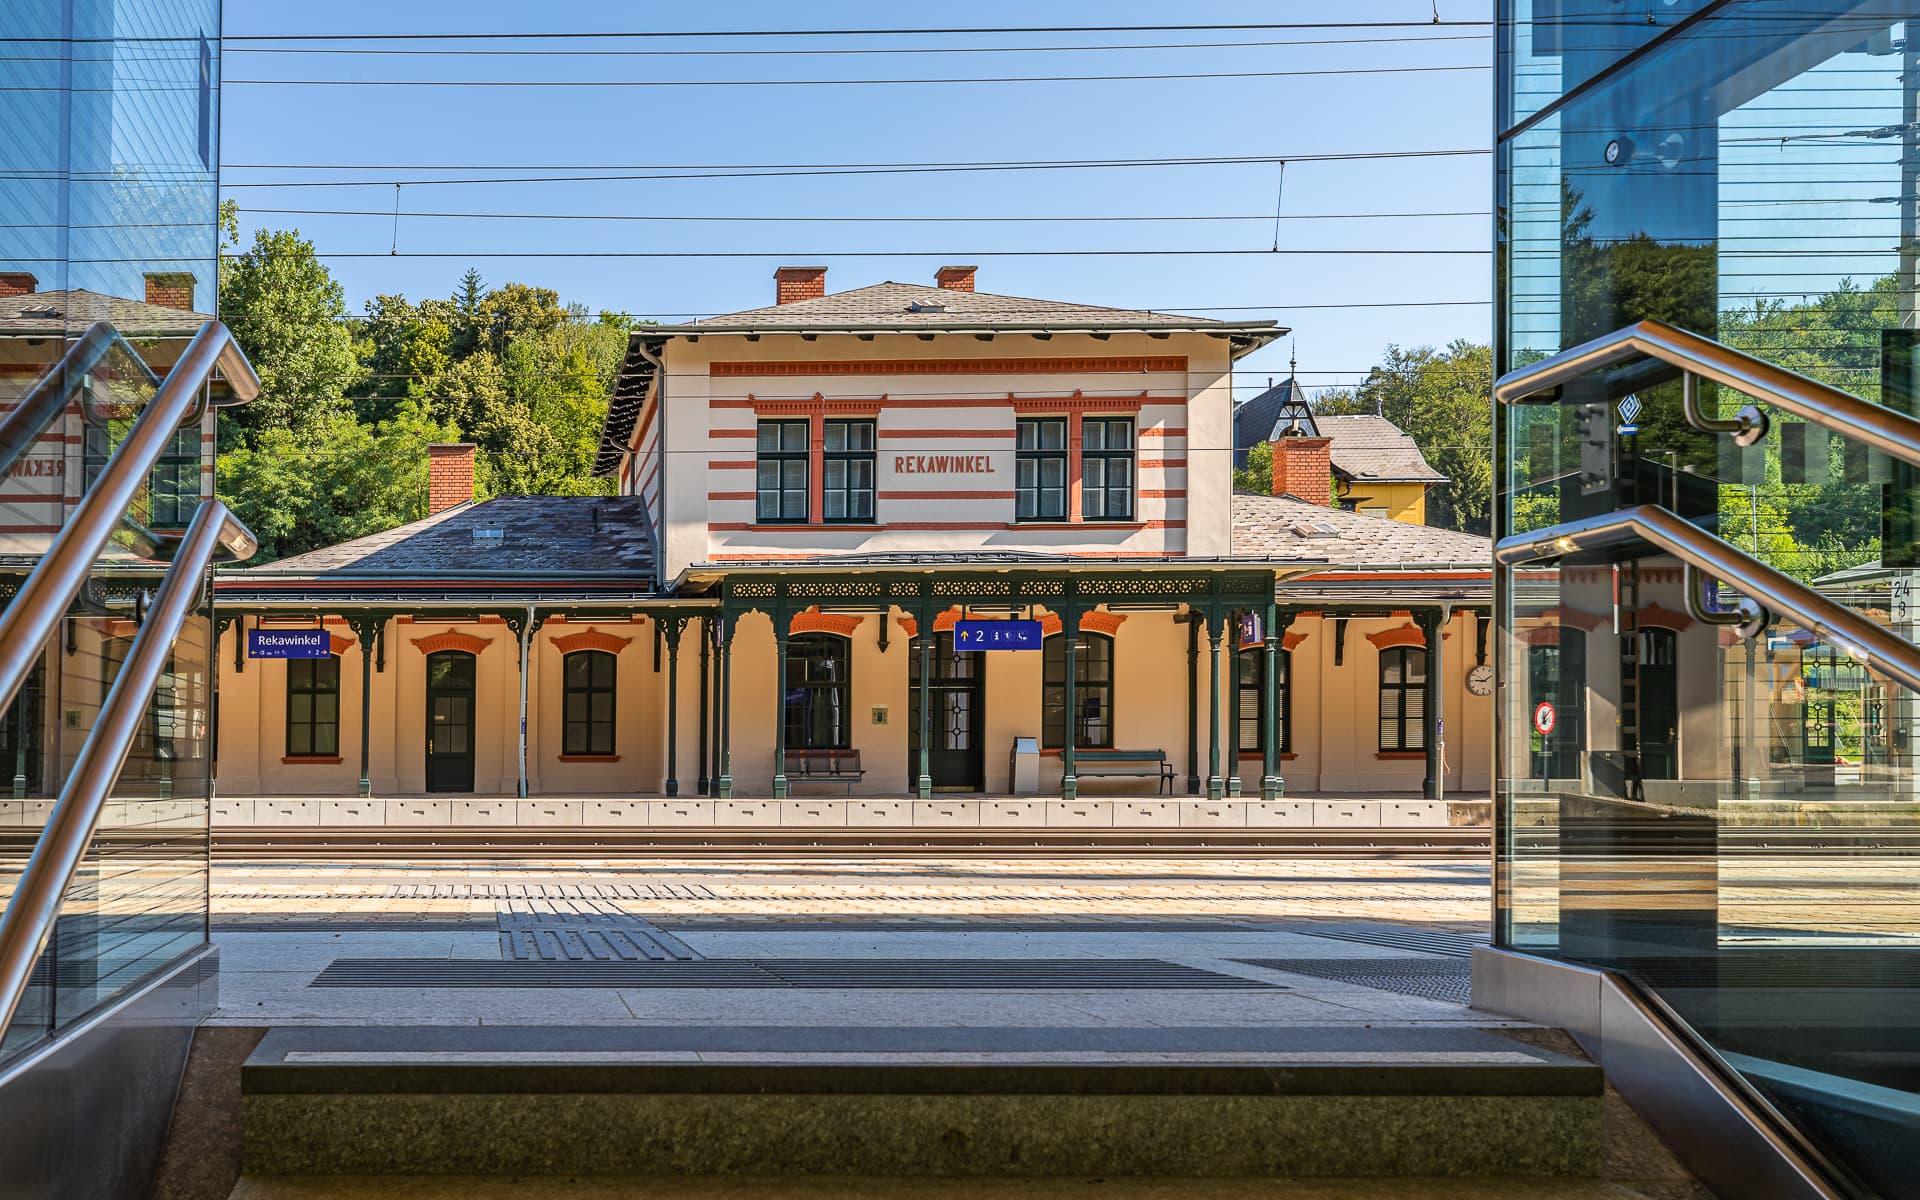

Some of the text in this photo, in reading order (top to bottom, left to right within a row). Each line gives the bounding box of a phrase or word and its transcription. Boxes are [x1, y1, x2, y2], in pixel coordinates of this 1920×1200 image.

[895, 456, 995, 473] REKAWINKEL
[1894, 580, 1910, 598] 24
[258, 635, 320, 645] Rekawinkel
[976, 630, 984, 642] 2
